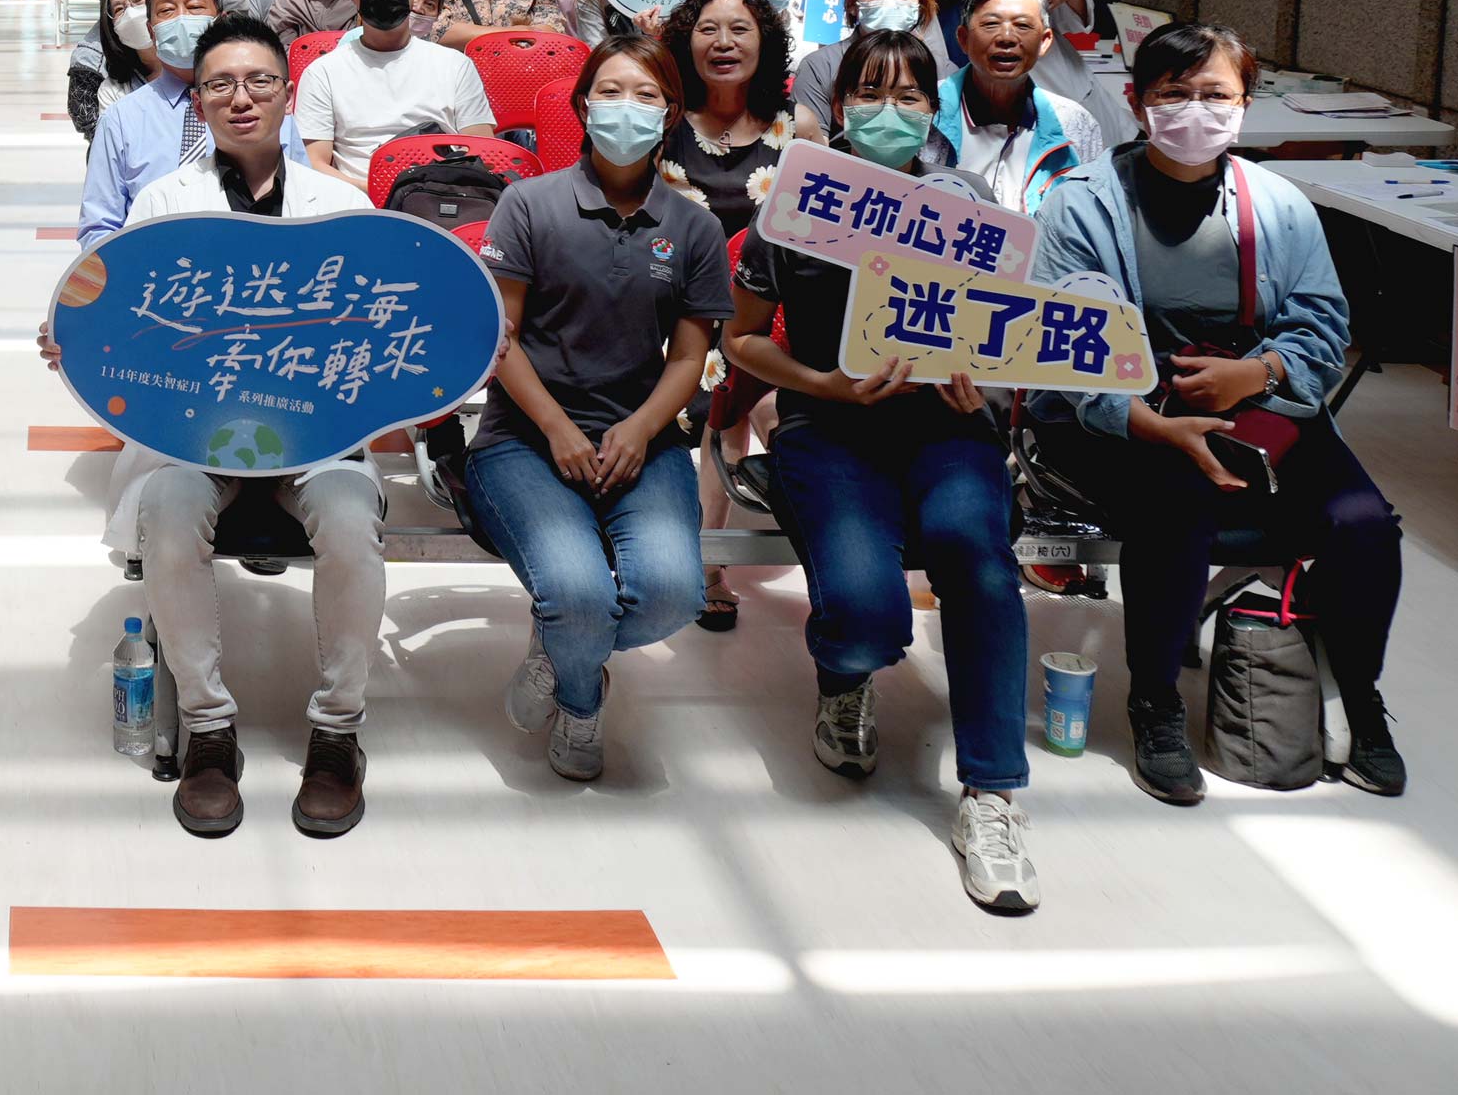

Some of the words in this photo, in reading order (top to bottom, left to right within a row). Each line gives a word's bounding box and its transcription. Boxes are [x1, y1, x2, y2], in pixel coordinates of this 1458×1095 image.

[796, 171, 1007, 274] 在你心裡
[884, 274, 1111, 376] 迷了路
[100, 364, 202, 395] 114年度失智症月
[238, 389, 315, 415] 系列推廣活動
